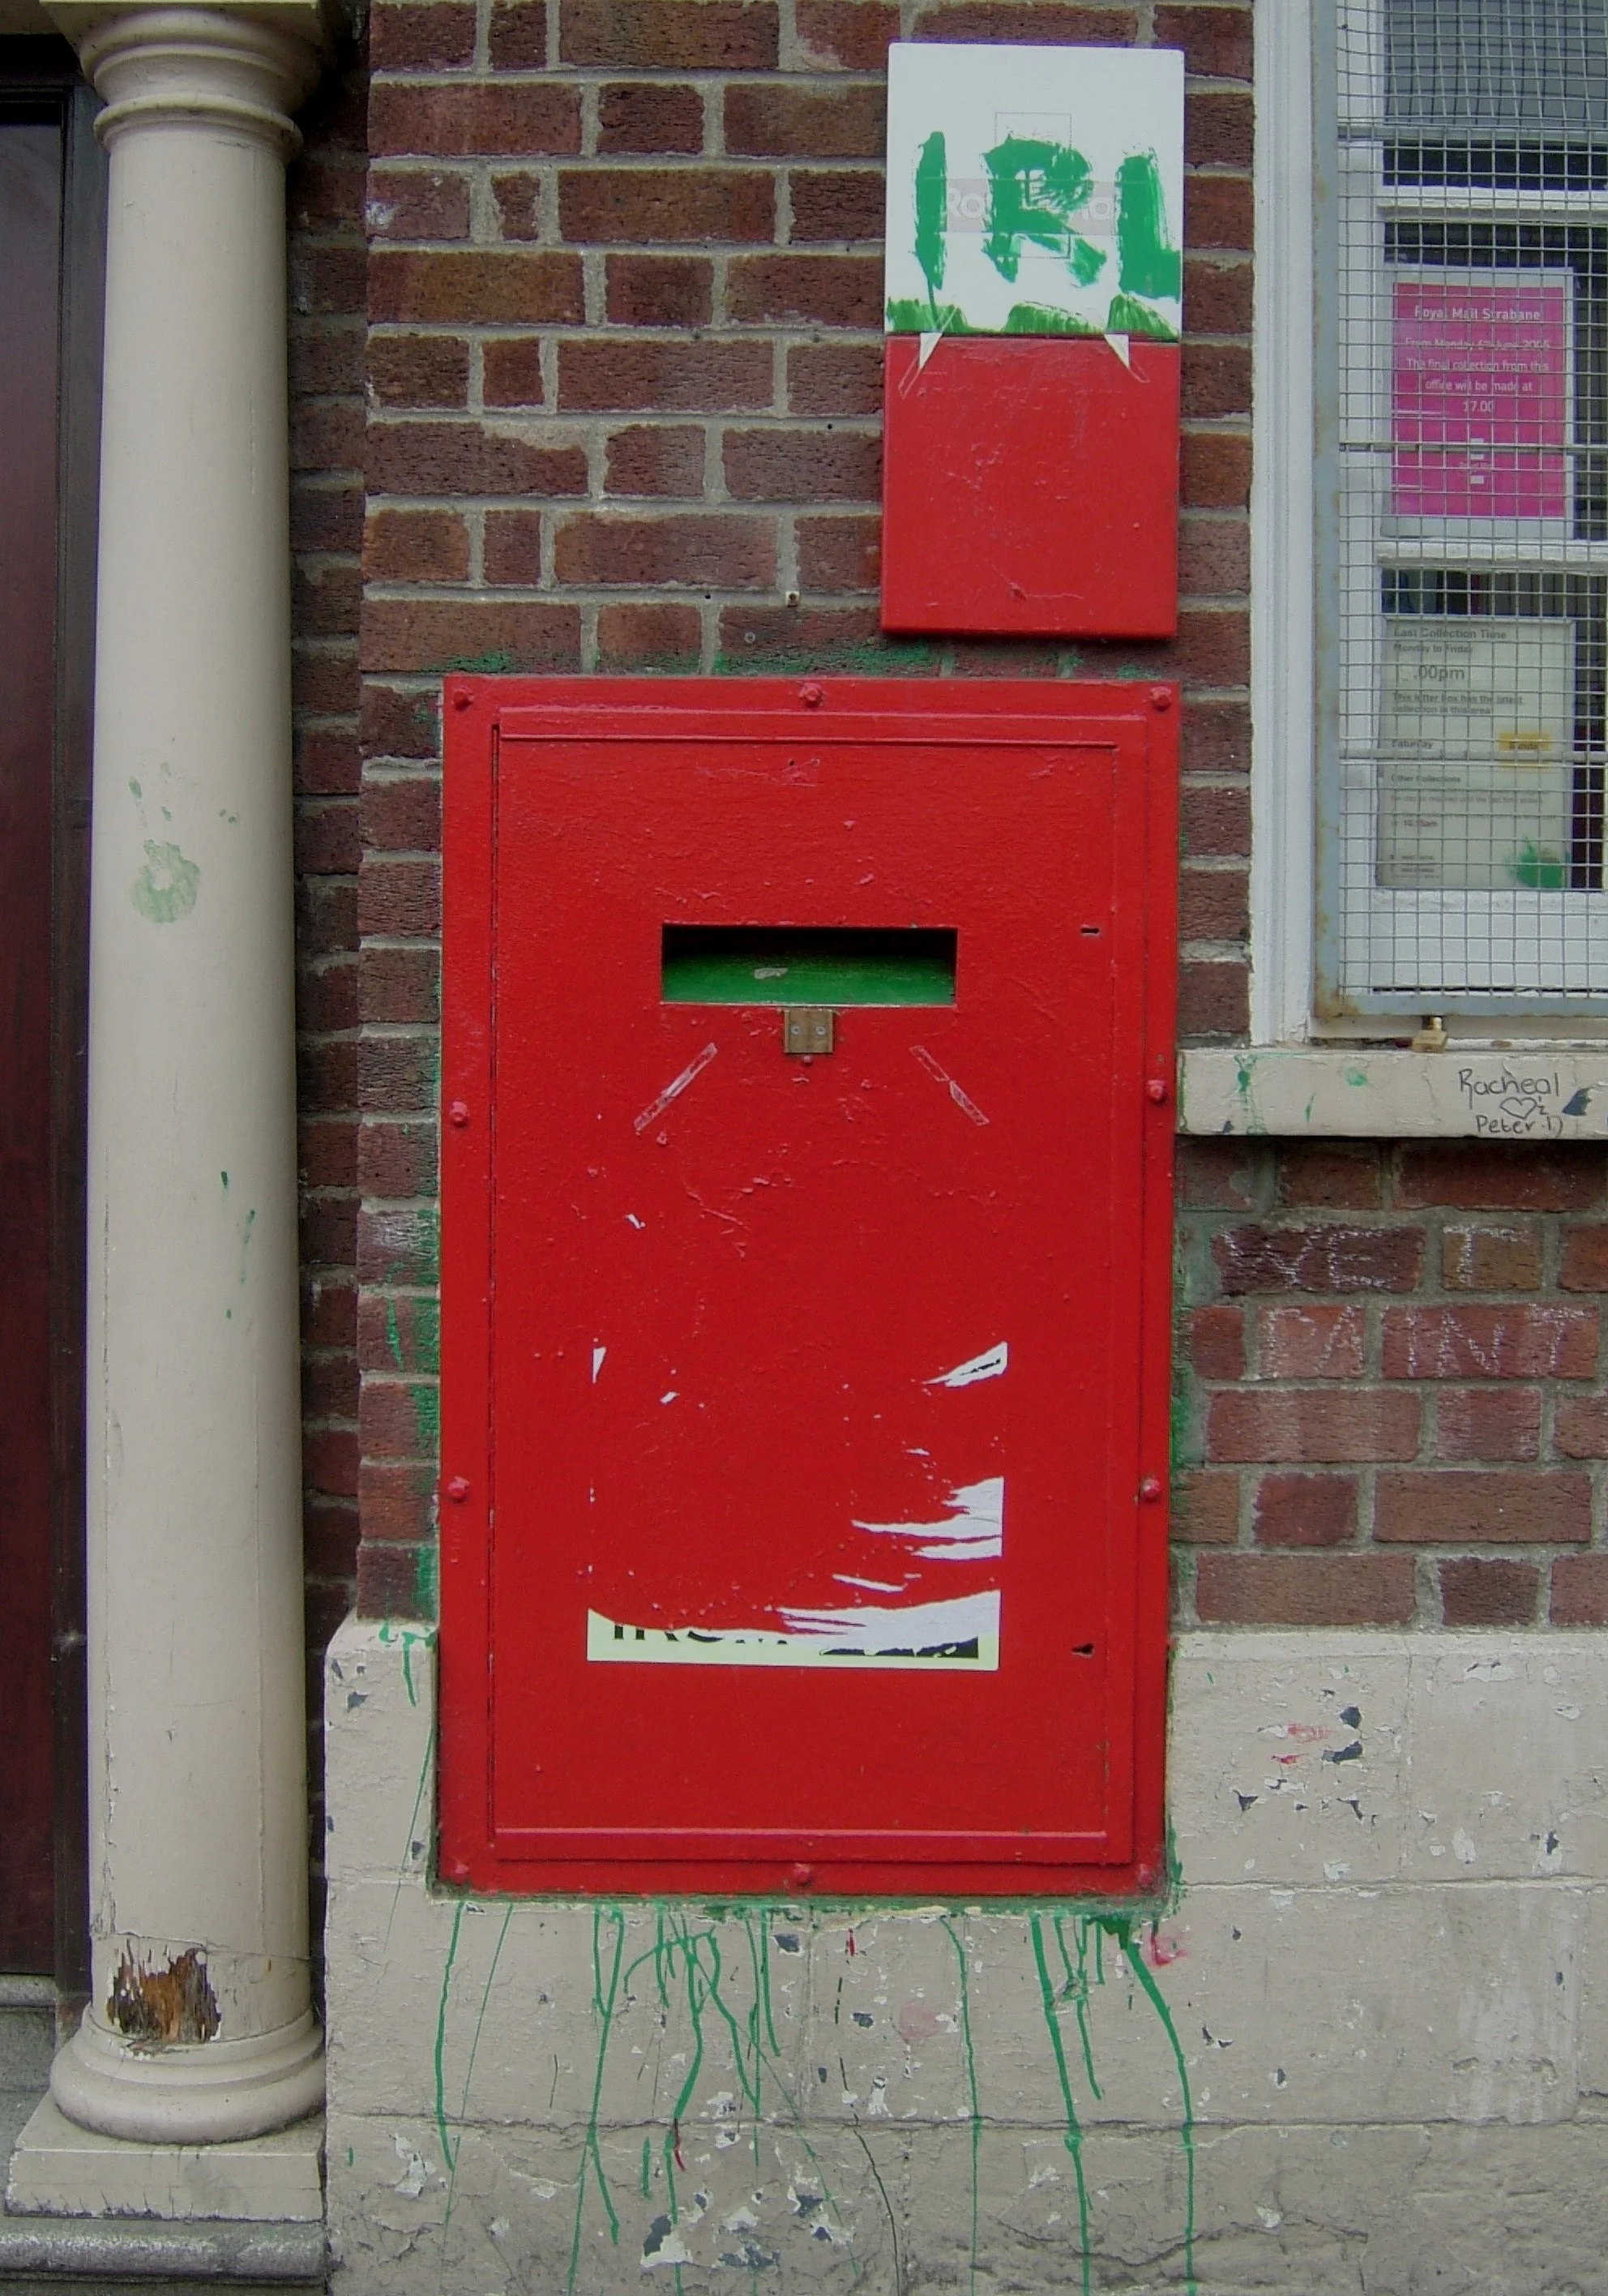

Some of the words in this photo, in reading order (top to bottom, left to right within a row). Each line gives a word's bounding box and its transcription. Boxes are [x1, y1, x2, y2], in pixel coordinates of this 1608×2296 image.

[1415, 306, 1445, 319] Roya
[1452, 307, 1478, 319] Mail
[1407, 358, 1425, 370] The
[1503, 361, 1528, 371] from
[1425, 379, 1452, 391] office
[1455, 379, 1472, 391] will
[1476, 380, 1488, 391] be
[1493, 381, 1518, 392] made
[1522, 382, 1533, 392] at
[1393, 628, 1417, 637] Last
[1420, 628, 1476, 639] Collection
[1433, 644, 1442, 653] to
[1458, 1068, 1559, 1110] Racheal
[1475, 1114, 1536, 1134] Peter
[1218, 1225, 1529, 1288] WET
[1265, 1302, 1594, 1377] PAINT
